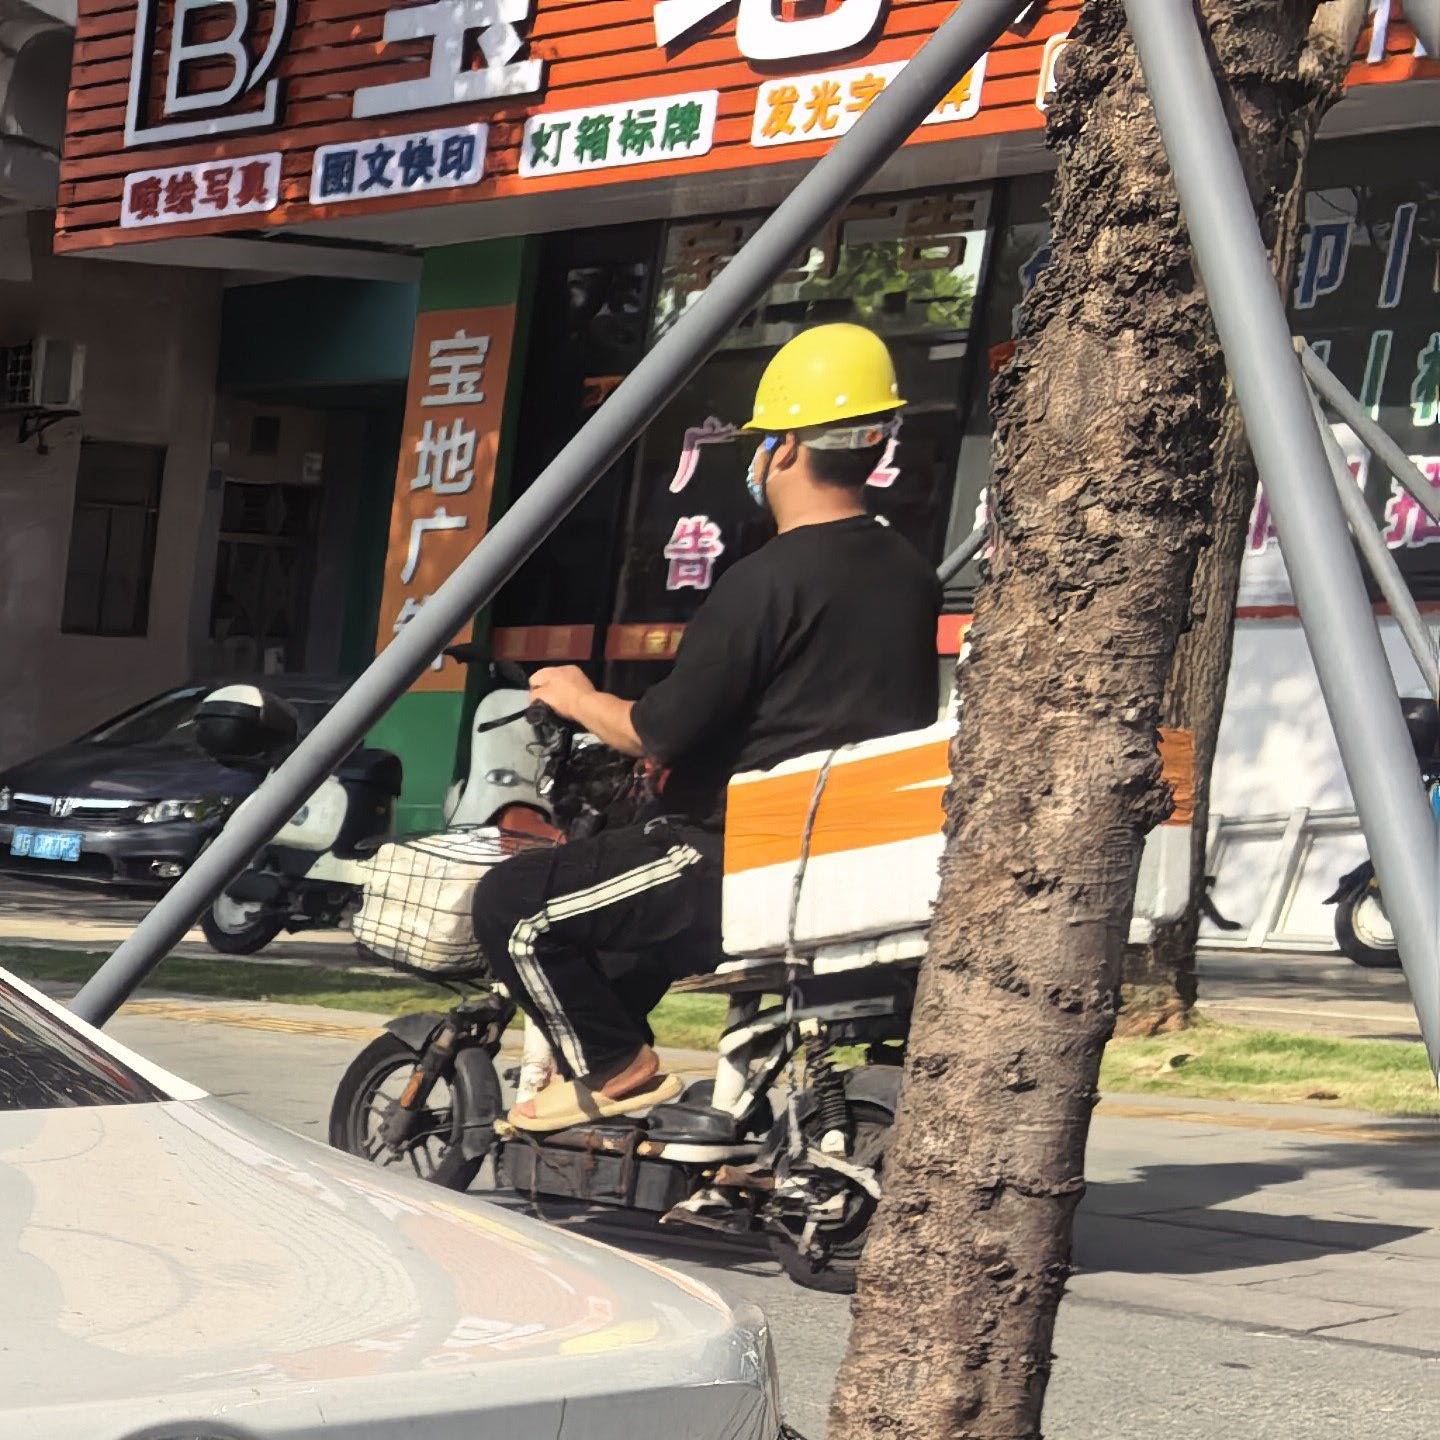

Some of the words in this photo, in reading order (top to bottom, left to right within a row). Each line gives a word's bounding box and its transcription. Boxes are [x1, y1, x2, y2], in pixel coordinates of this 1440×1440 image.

[530, 101, 702, 168] 灯箱标牌
[129, 160, 272, 221] 喷绘写真
